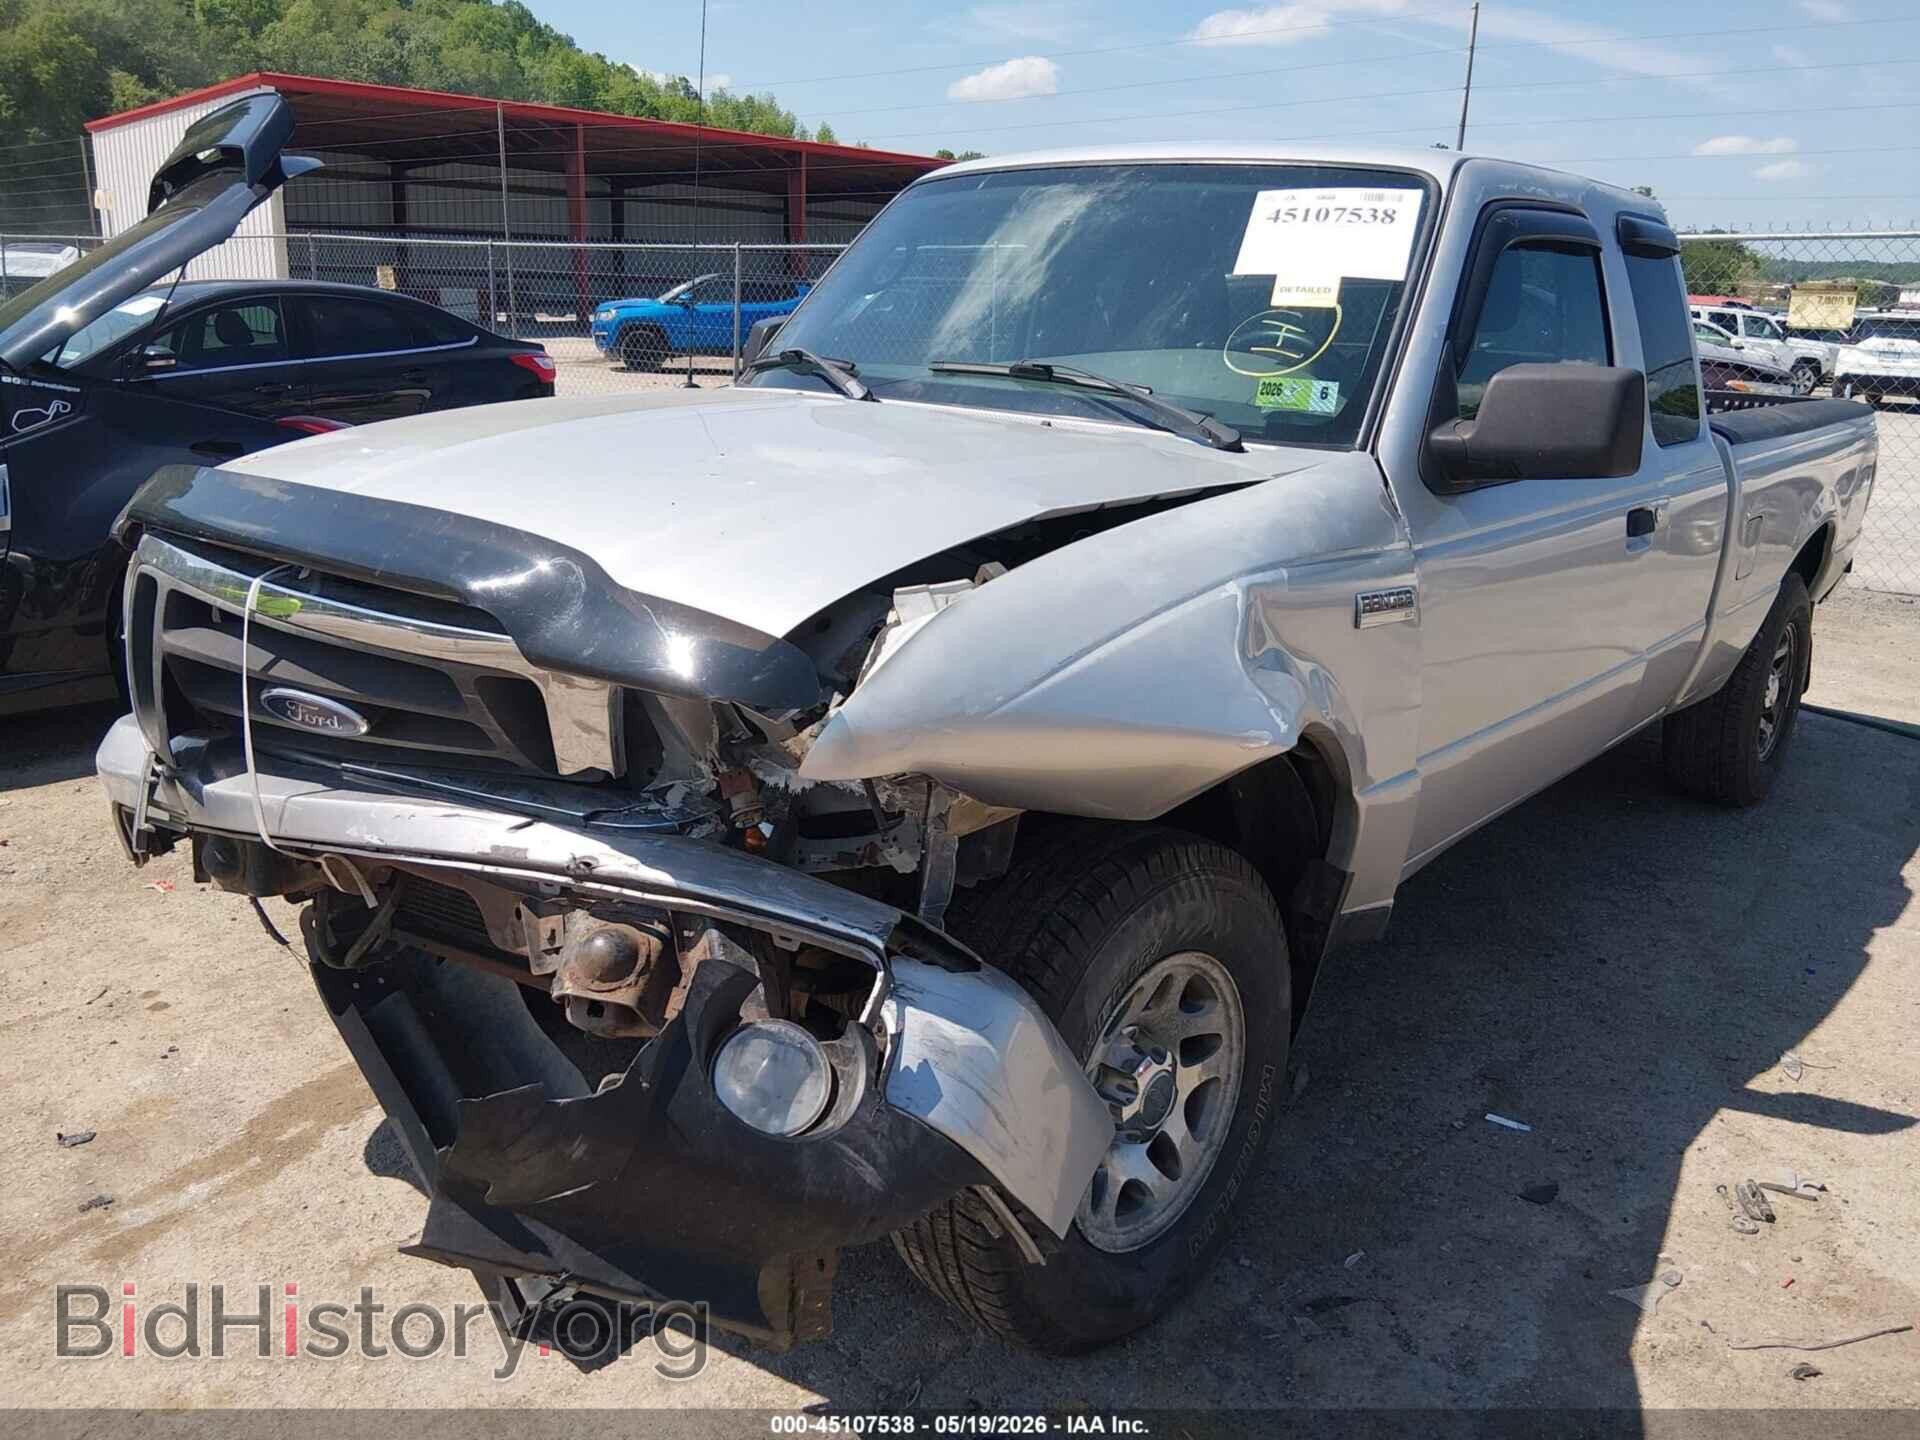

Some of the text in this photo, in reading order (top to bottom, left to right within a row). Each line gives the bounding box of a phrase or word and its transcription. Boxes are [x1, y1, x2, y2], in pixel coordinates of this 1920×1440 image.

[1266, 207, 1397, 225] 45107538
[1280, 286, 1332, 295] DETAILED
[1260, 382, 1329, 400] 2026 6
[286, 699, 343, 729] Ford
